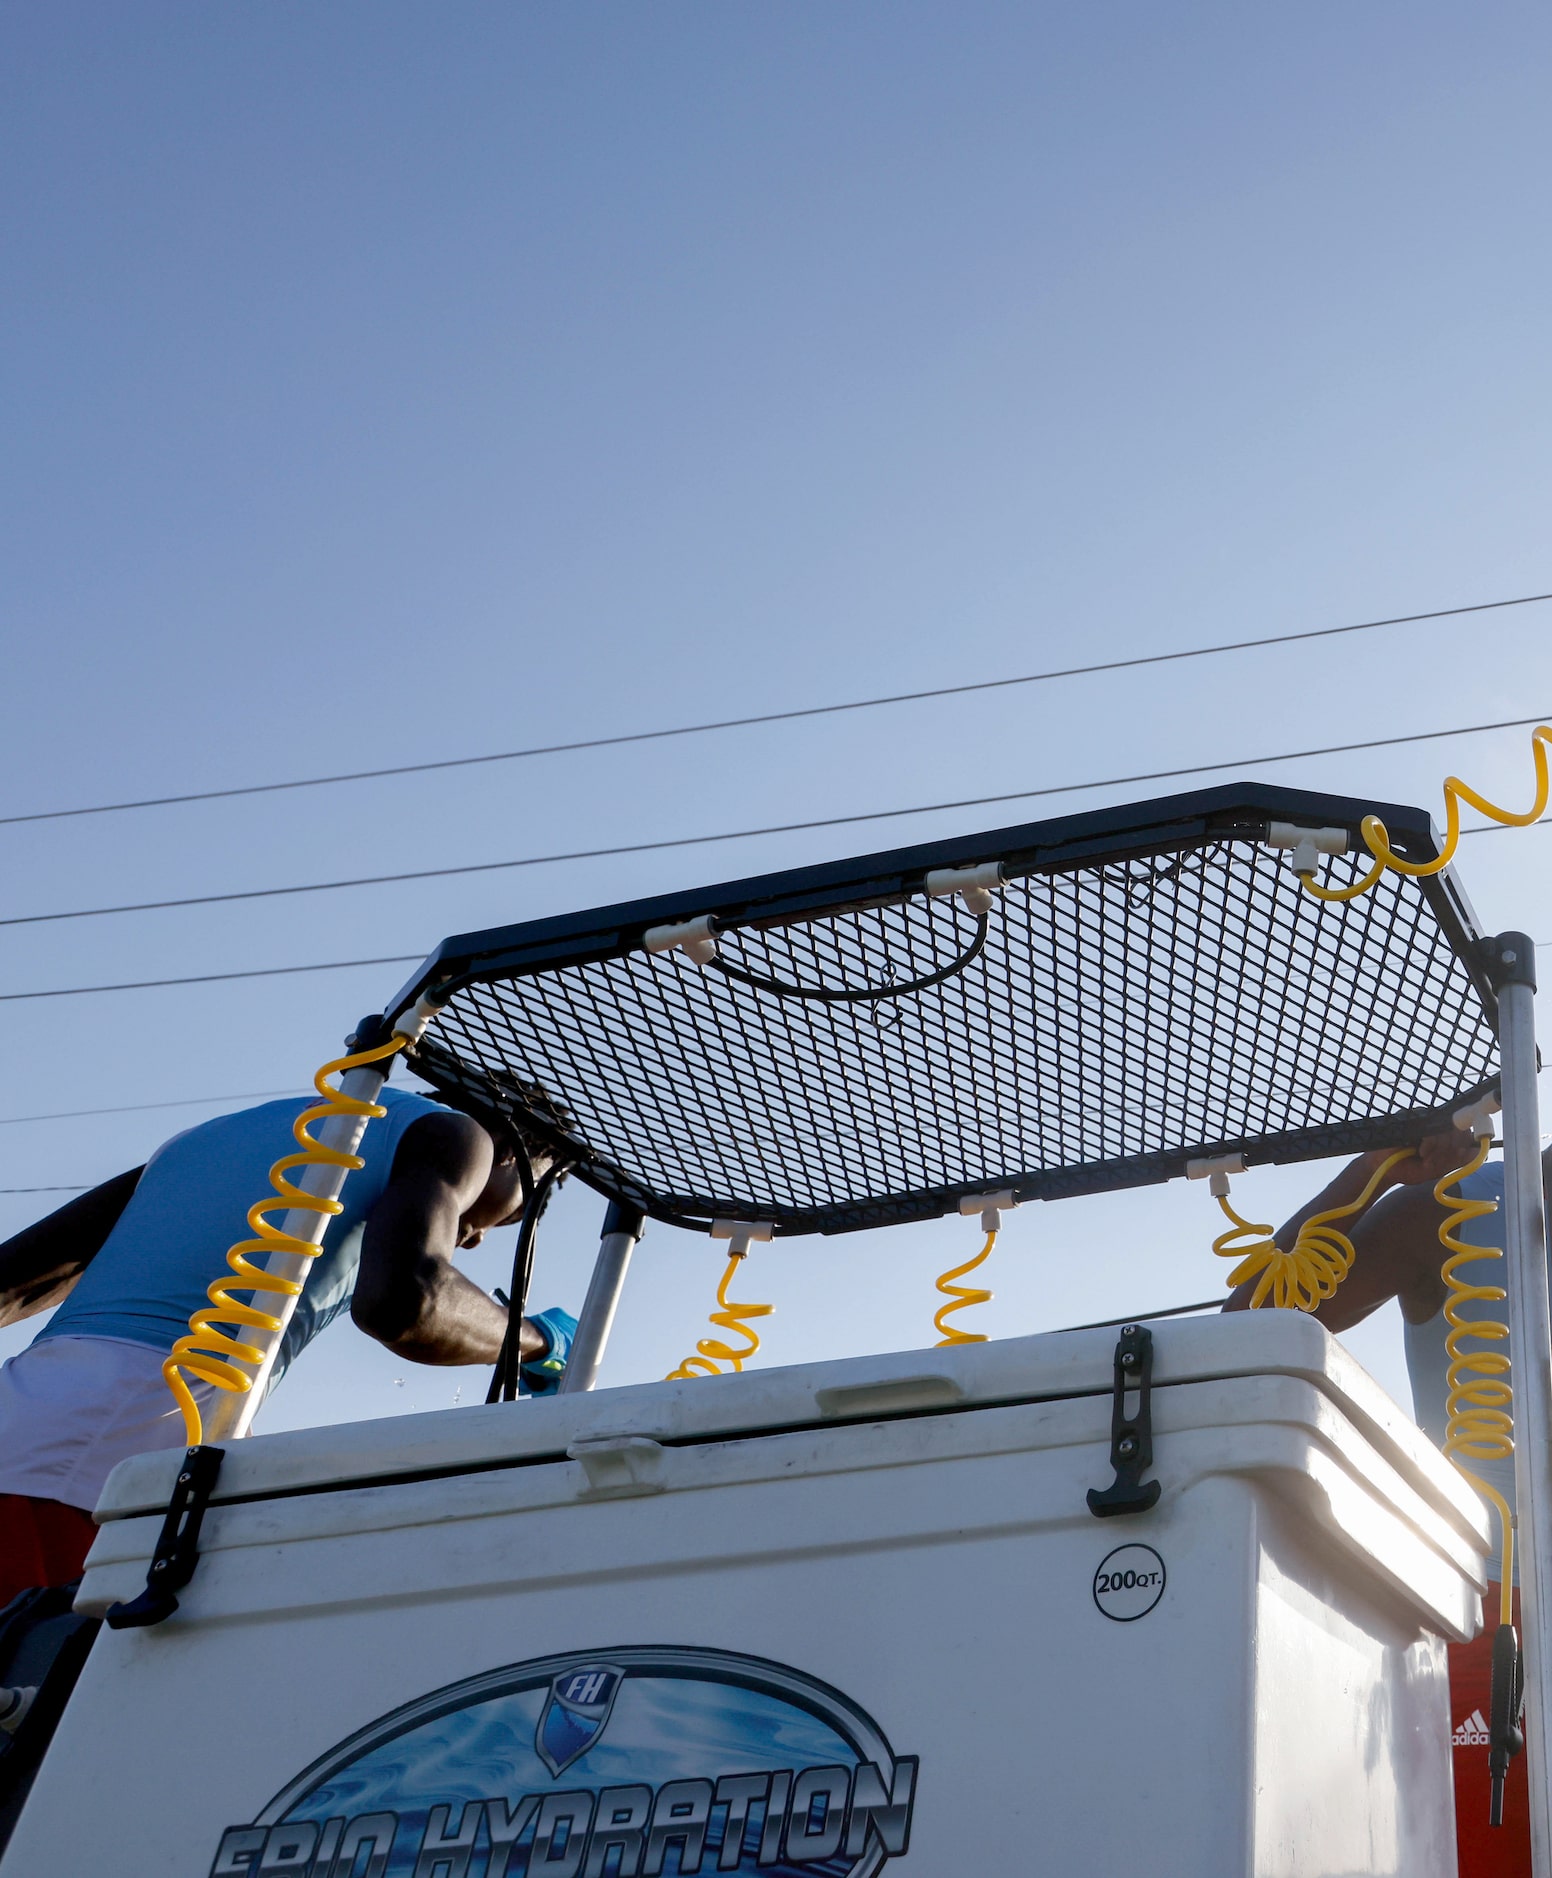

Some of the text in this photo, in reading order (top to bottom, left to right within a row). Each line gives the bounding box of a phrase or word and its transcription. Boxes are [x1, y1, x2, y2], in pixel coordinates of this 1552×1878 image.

[565, 1672, 608, 1703] FH
[1452, 1731, 1490, 1746] adida
[414, 1754, 920, 1878] HYDRATION
